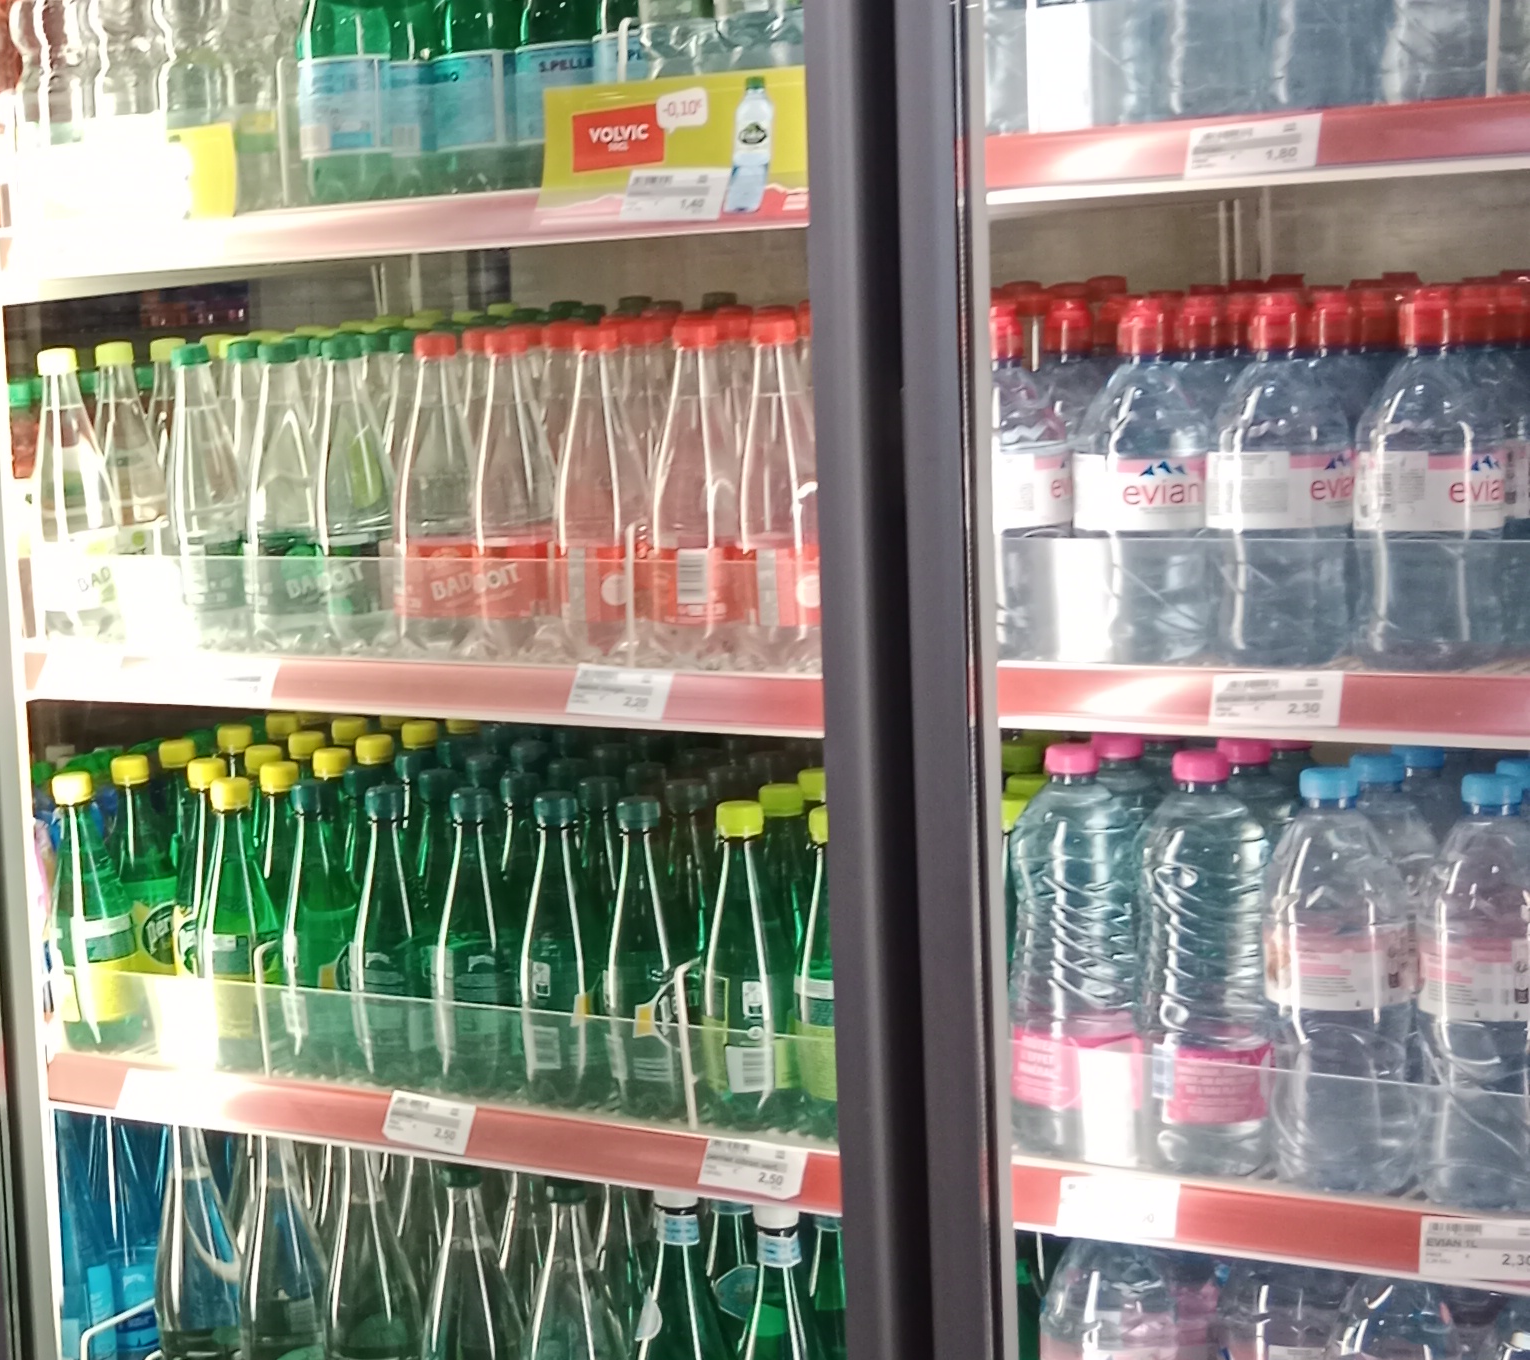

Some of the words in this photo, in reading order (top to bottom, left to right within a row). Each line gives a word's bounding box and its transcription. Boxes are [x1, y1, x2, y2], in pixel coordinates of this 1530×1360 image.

[589, 124, 649, 144] VOLVIC
[1123, 476, 1202, 507] evian
[1449, 472, 1504, 503] evia
[1287, 703, 1321, 715] 2,30
[758, 1171, 784, 1186] 2,50
[1426, 1238, 1462, 1247] EVIAN
